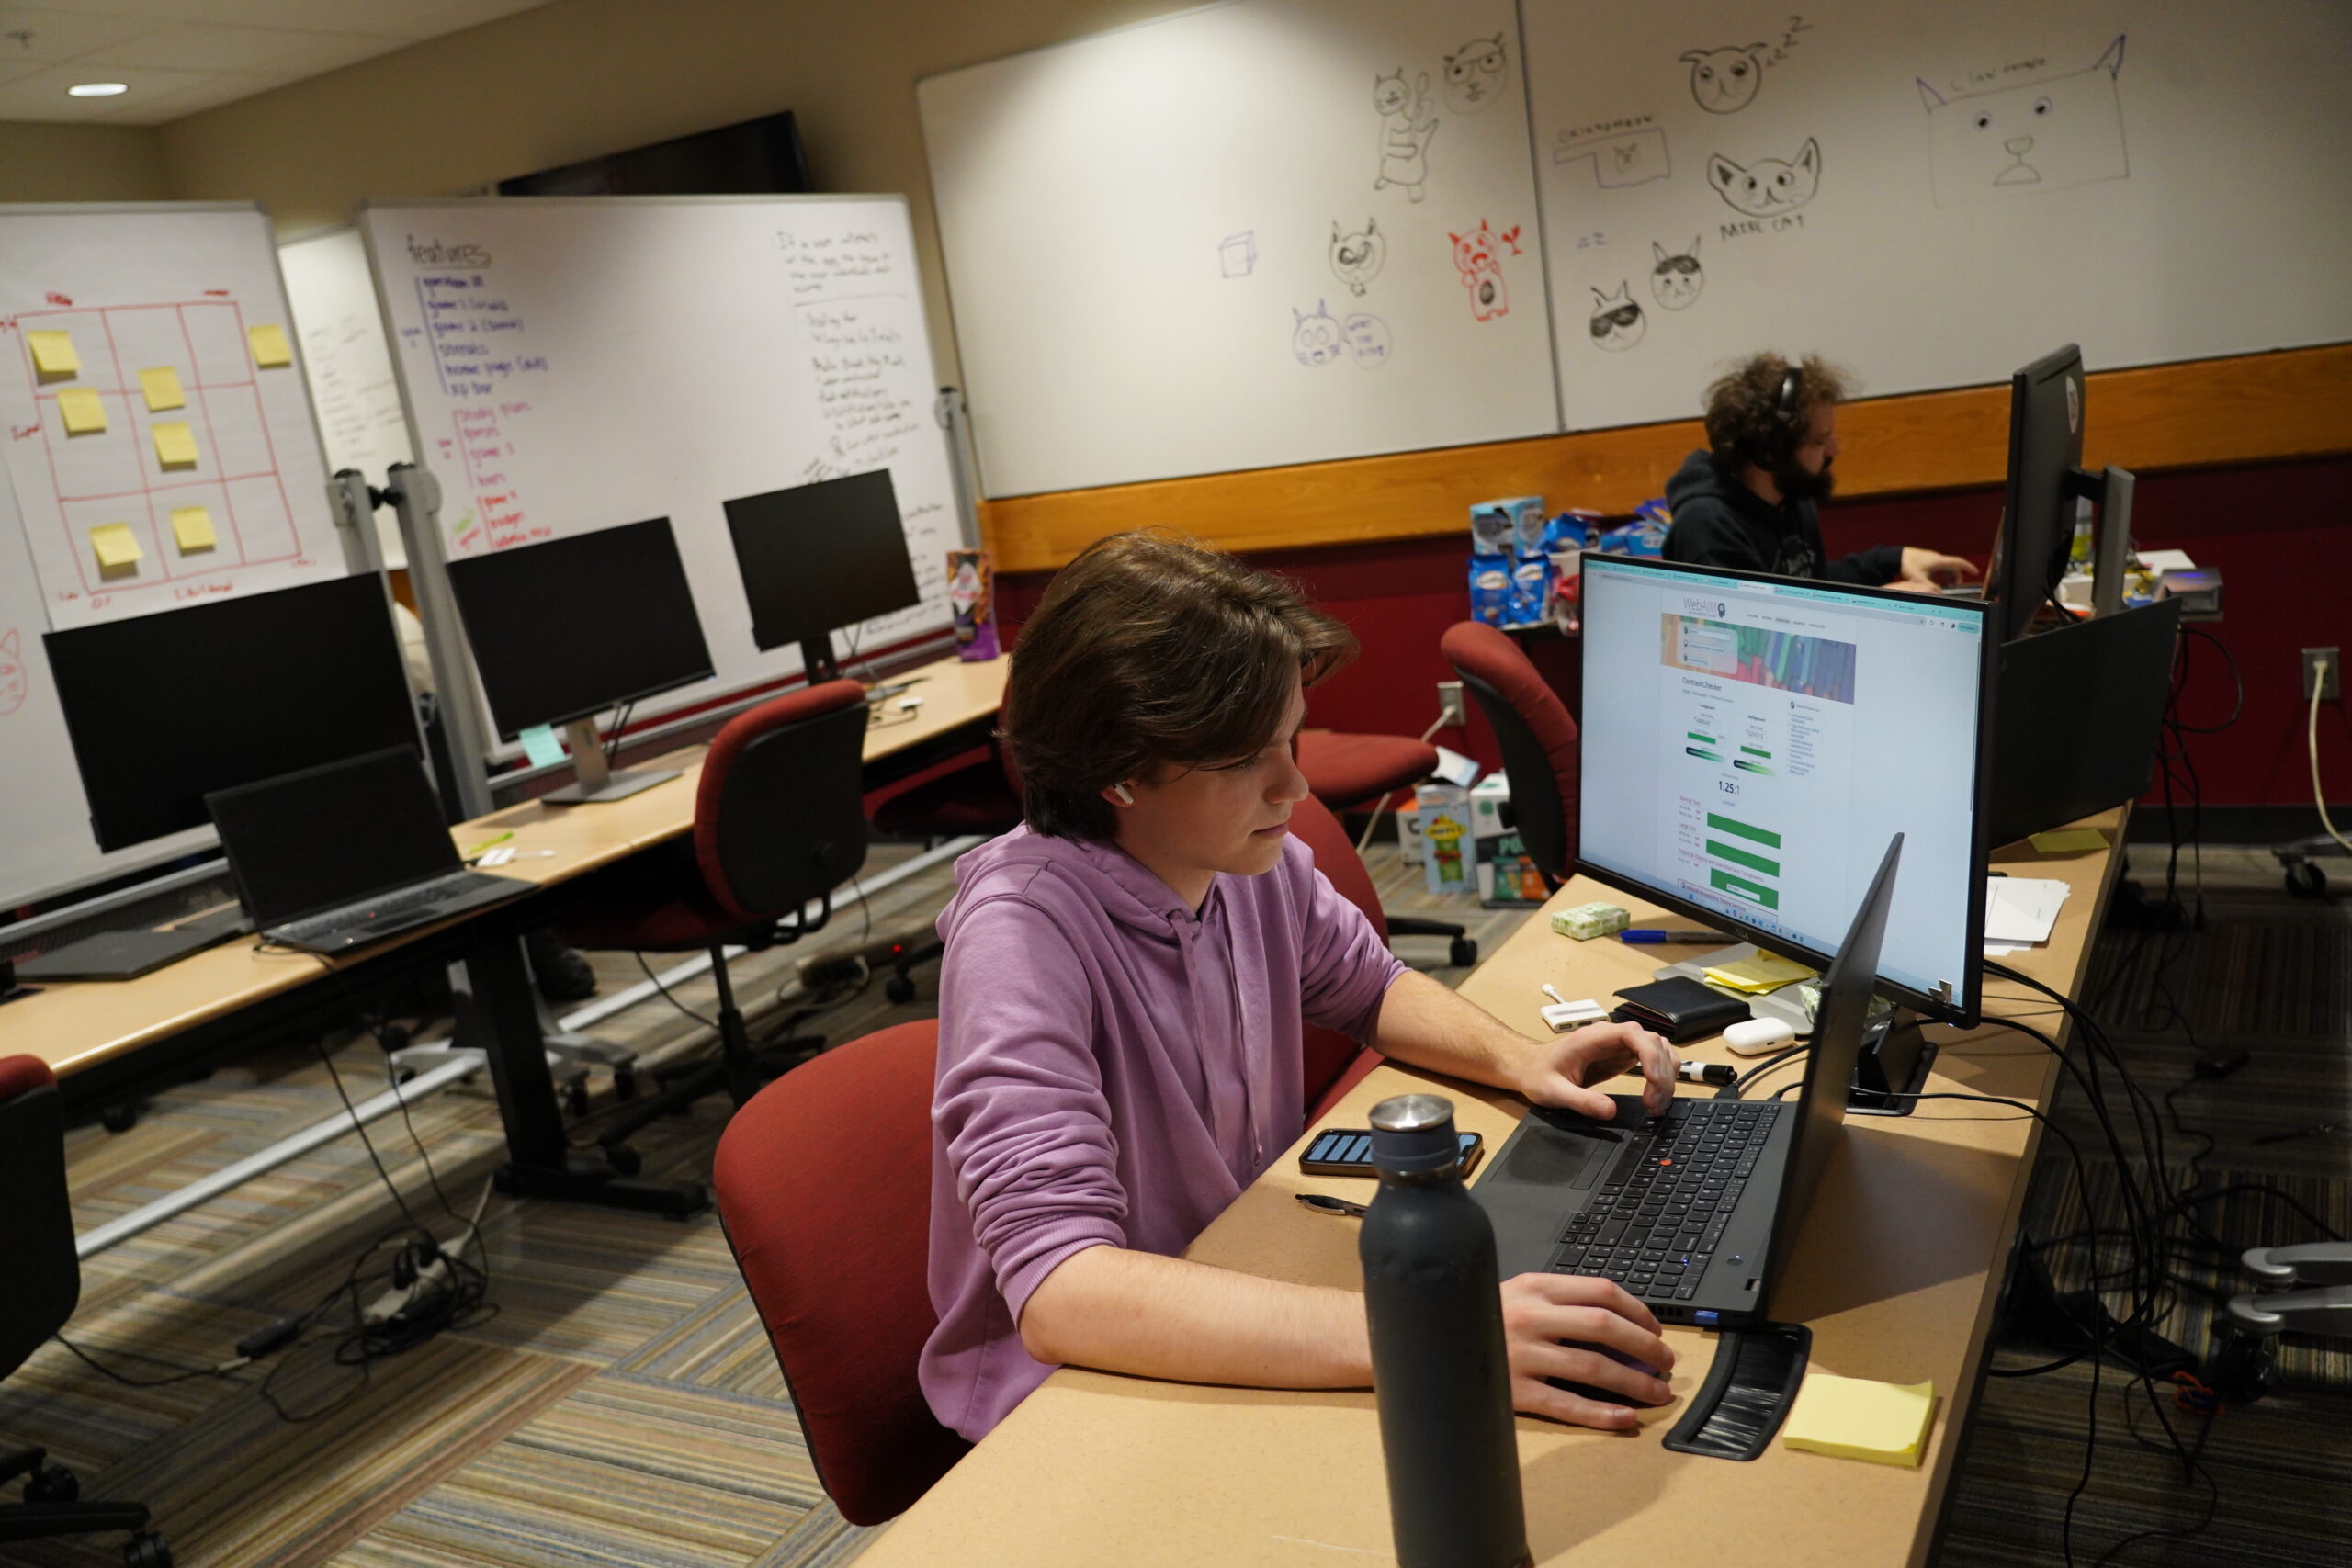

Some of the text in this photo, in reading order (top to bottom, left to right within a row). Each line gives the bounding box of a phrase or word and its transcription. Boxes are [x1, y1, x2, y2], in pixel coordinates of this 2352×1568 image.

[1683, 597, 1717, 614] WebAIM
[1682, 677, 1723, 692] Contrast Checker
[1718, 780, 1740, 796] 1.25:1
